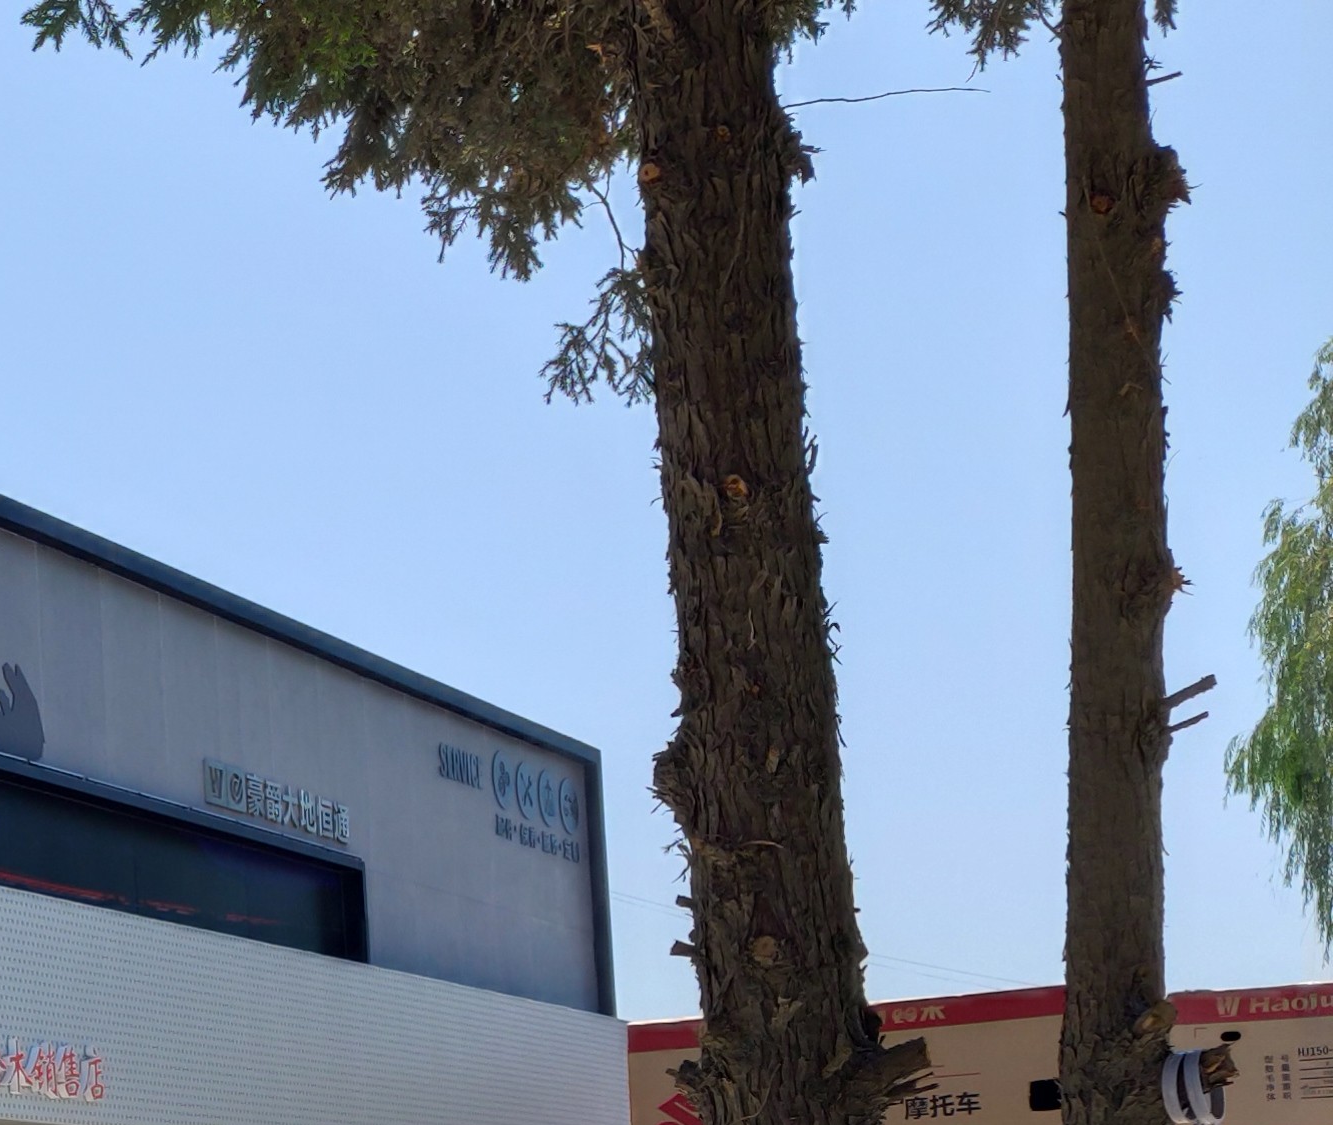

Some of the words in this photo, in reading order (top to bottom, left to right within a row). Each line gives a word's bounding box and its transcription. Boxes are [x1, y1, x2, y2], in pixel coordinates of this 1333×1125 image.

[438, 742, 482, 790] SERVICE
[246, 773, 350, 845] 豪爵大地恒通
[904, 1091, 982, 1120] 摩托车
